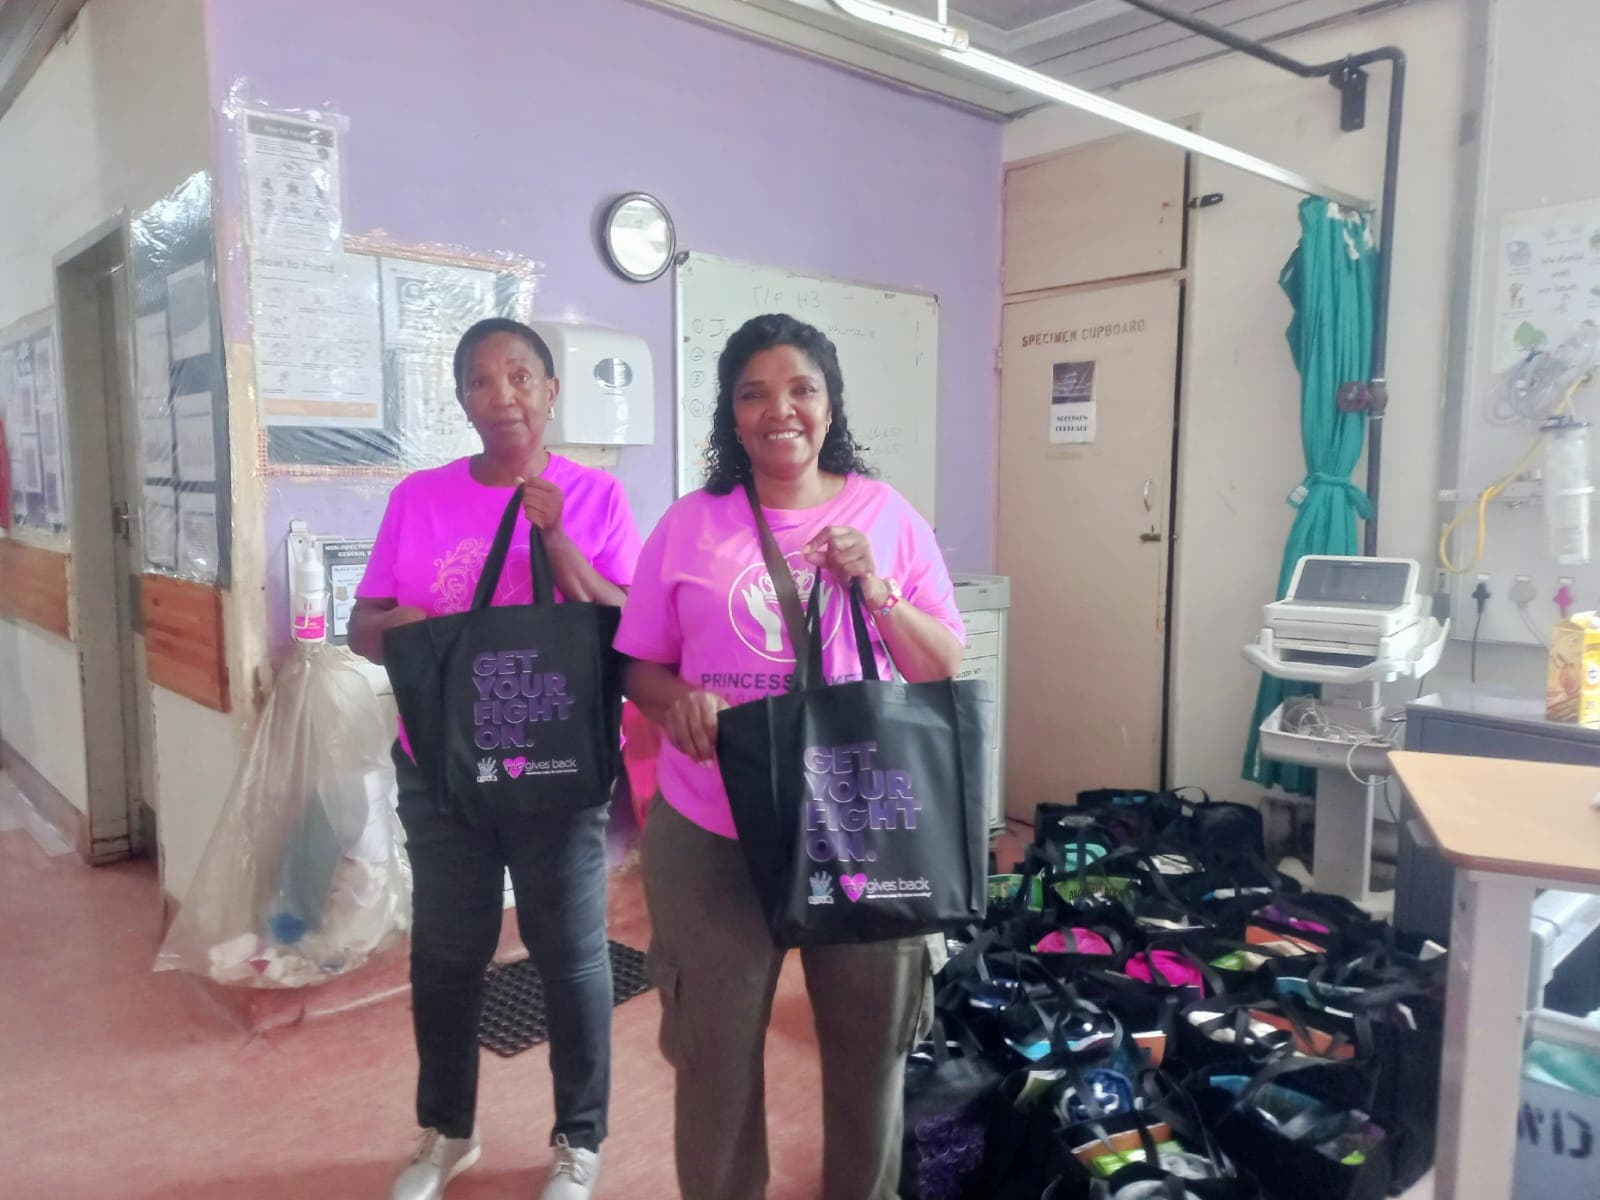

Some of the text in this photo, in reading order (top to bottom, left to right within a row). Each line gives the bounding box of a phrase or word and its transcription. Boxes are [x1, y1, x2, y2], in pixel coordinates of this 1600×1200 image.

[1021, 319, 1146, 348] SPECIMEN CUPBOARD
[472, 649, 539, 676] GET
[471, 672, 568, 700] YOUR
[701, 672, 792, 690] PRINCESS
[473, 697, 576, 726] FIGHT
[473, 723, 536, 751] ON.
[525, 760, 551, 773] gives
[551, 757, 577, 769] back
[803, 740, 878, 774] GET
[803, 769, 915, 804] YOUR
[806, 799, 923, 832] FIGHT
[805, 831, 878, 863] ON.
[865, 878, 897, 894] gives
[897, 876, 930, 891] back
